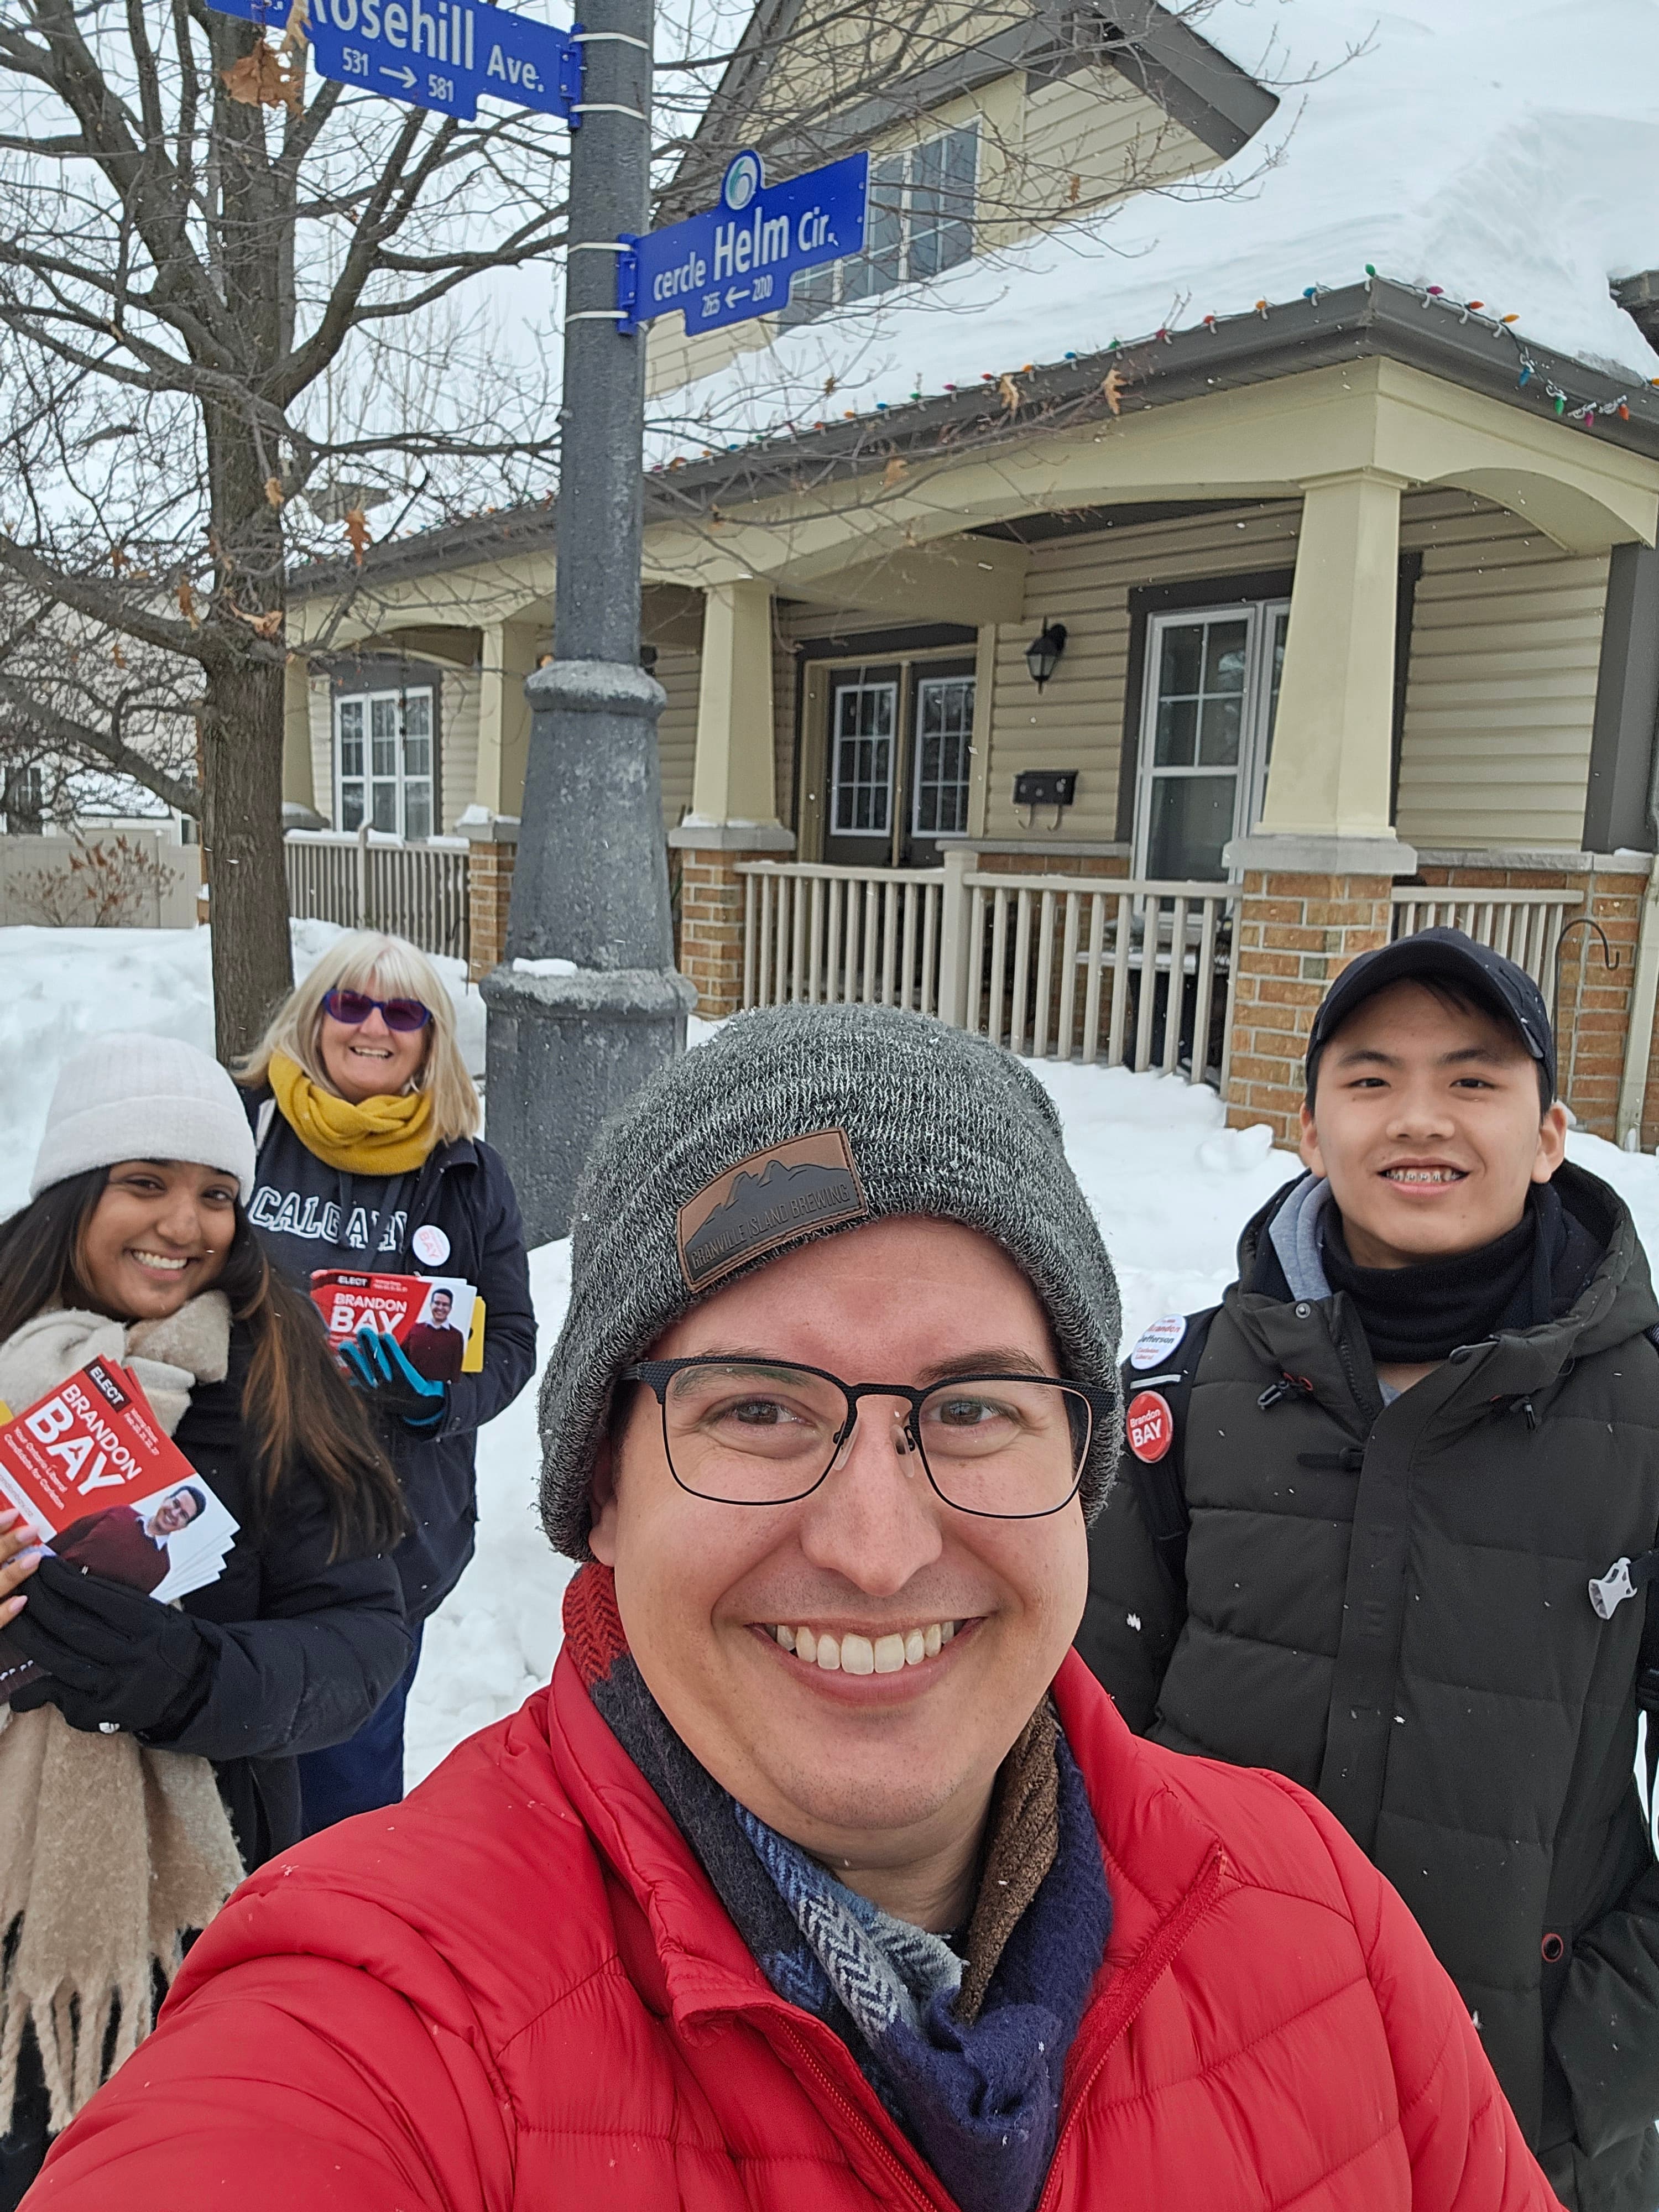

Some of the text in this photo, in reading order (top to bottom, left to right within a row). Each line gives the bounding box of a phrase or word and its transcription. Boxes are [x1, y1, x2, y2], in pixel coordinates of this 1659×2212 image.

[342, 46, 454, 102] 531 581
[487, 45, 545, 92] Ave.
[653, 206, 835, 301] cercle Helm Cir.
[752, 274, 773, 301] 200
[691, 1183, 851, 1270] GRANVILLE ISLAND BREWING
[337, 1275, 368, 1287] ELECT
[330, 1305, 405, 1335] BAY
[333, 1292, 408, 1313] BRANDON
[89, 1366, 124, 1405] ELECT
[61, 1383, 143, 1480] BRANDON
[1130, 1408, 1161, 1428] Brandon
[1132, 1418, 1161, 1447] BAY
[24, 1396, 126, 1496] BAY
